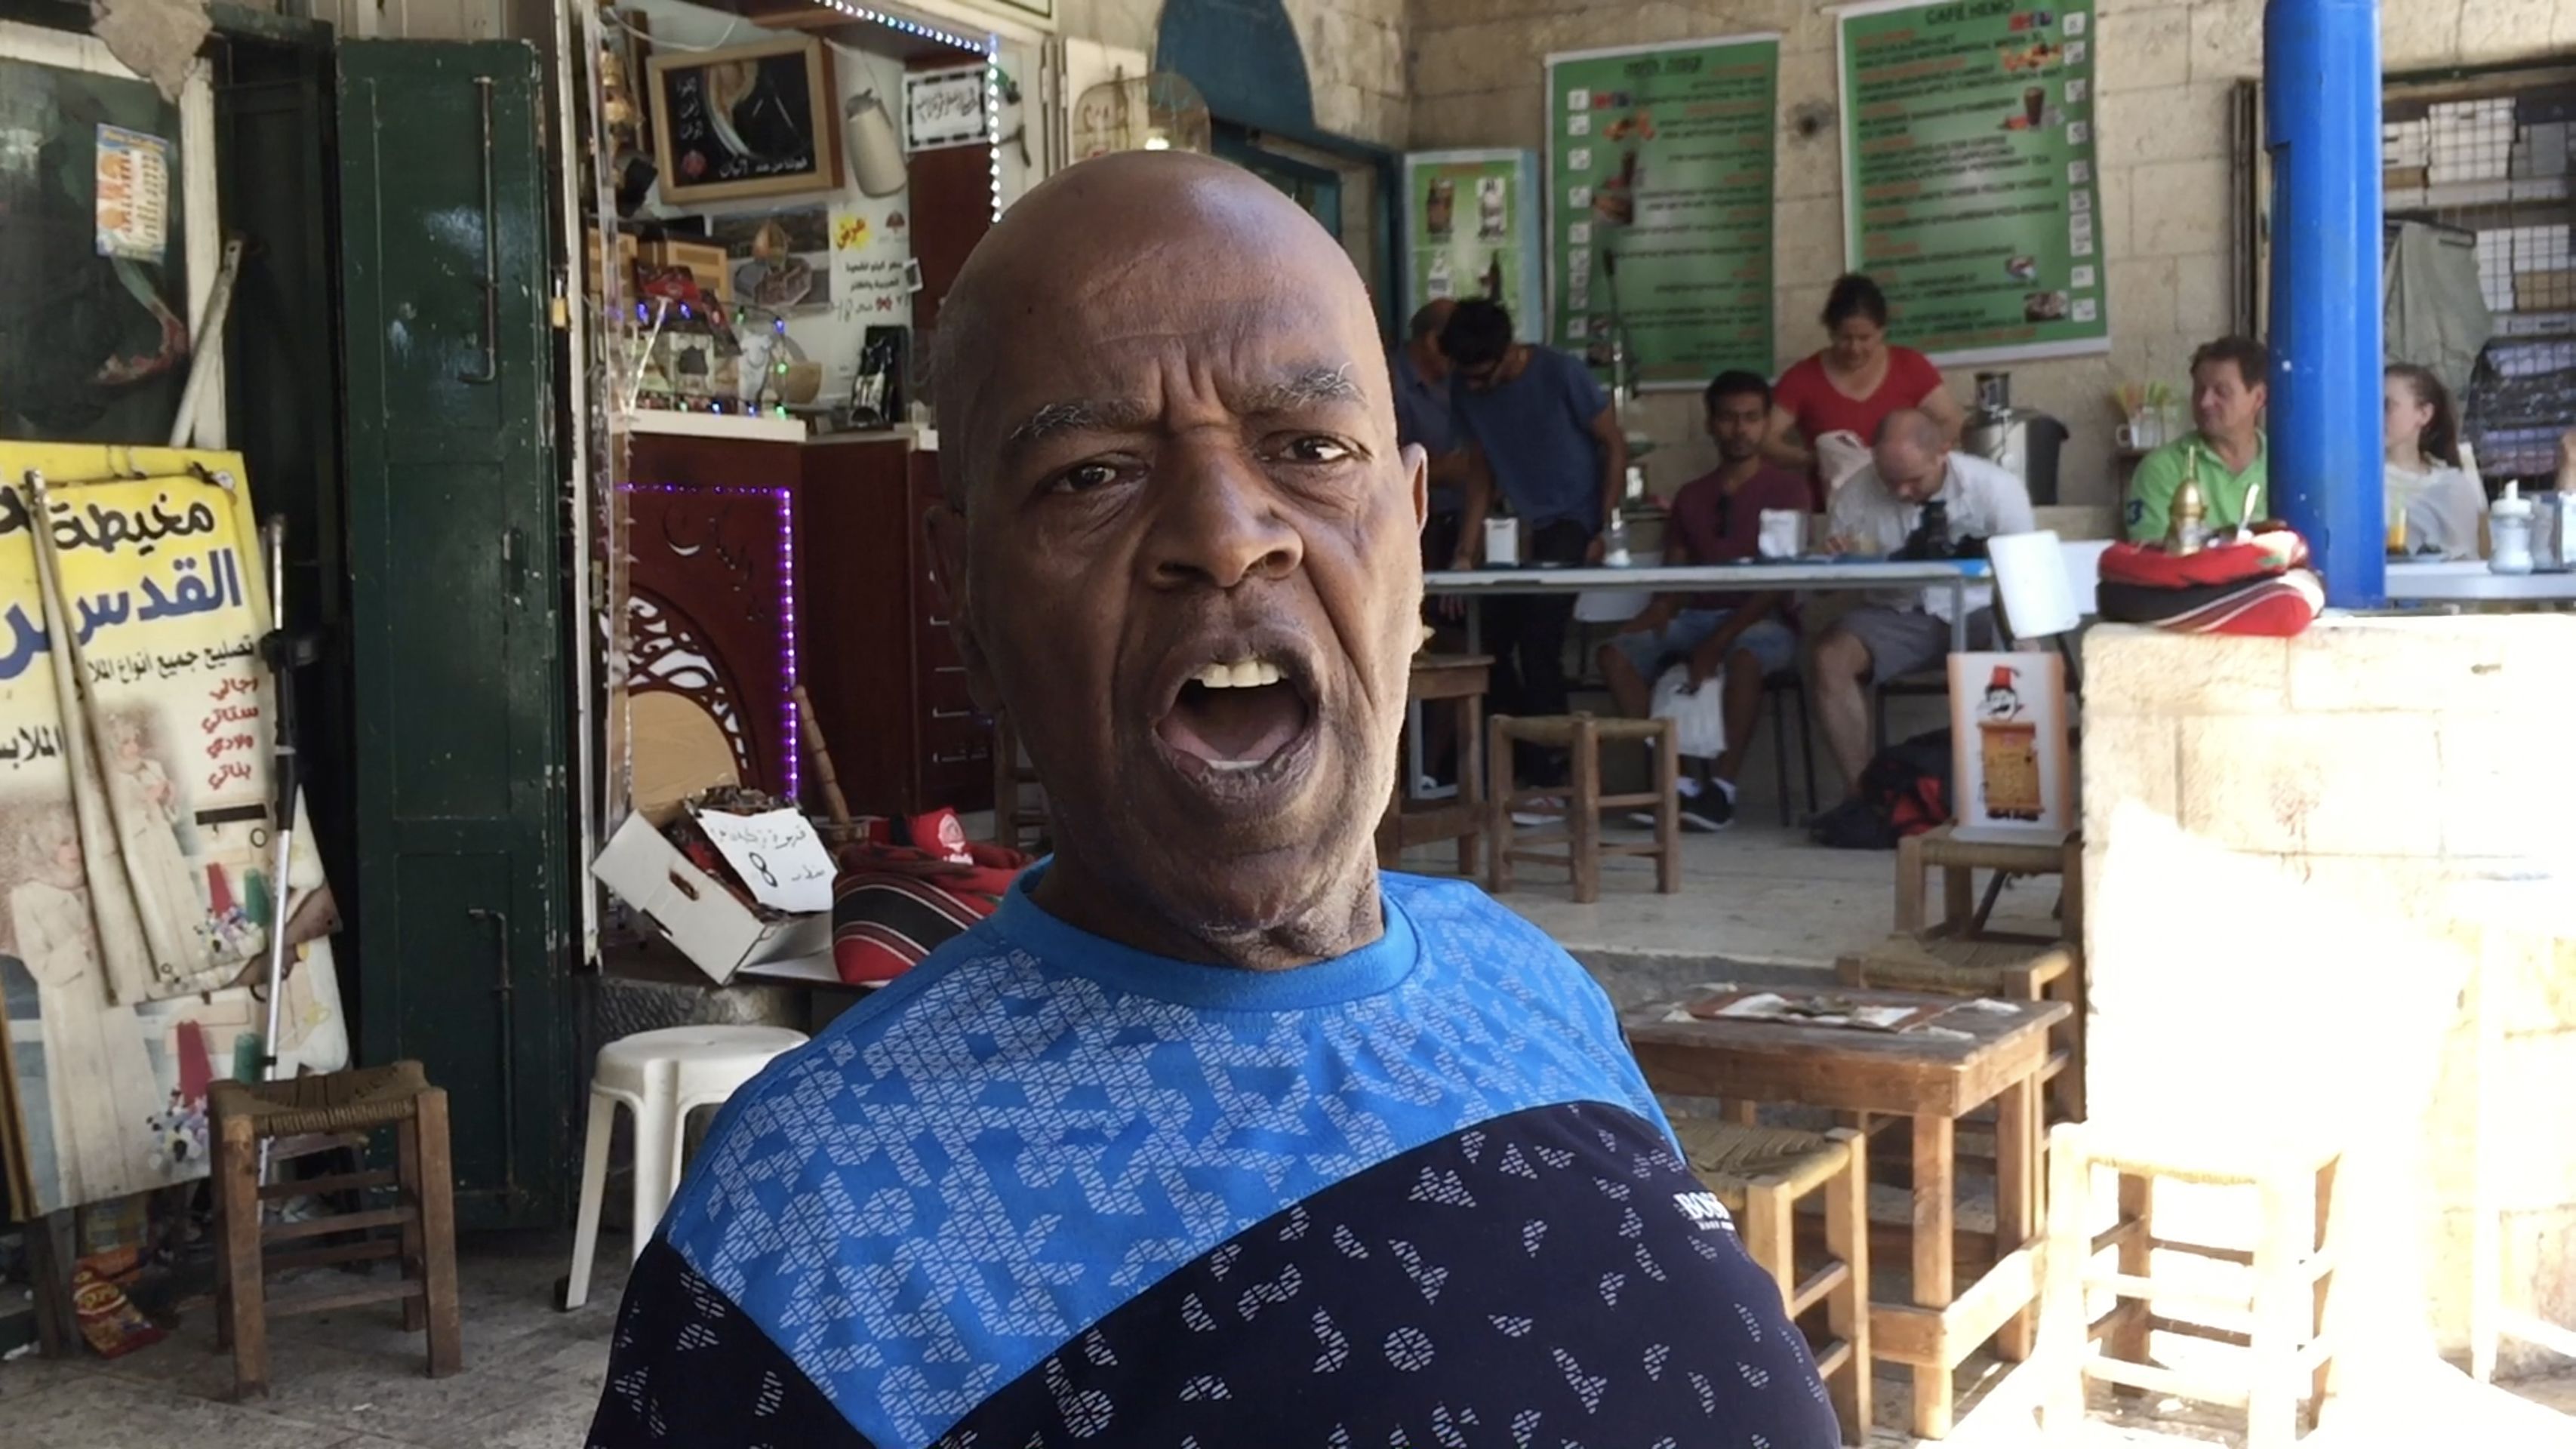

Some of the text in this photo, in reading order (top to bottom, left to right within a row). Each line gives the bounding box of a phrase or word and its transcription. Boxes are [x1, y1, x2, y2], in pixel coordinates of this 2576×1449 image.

[76, 547, 242, 646] القدس
[87, 657, 114, 683] الملا
[157, 651, 199, 679] جميع
[748, 851, 779, 888] 8
